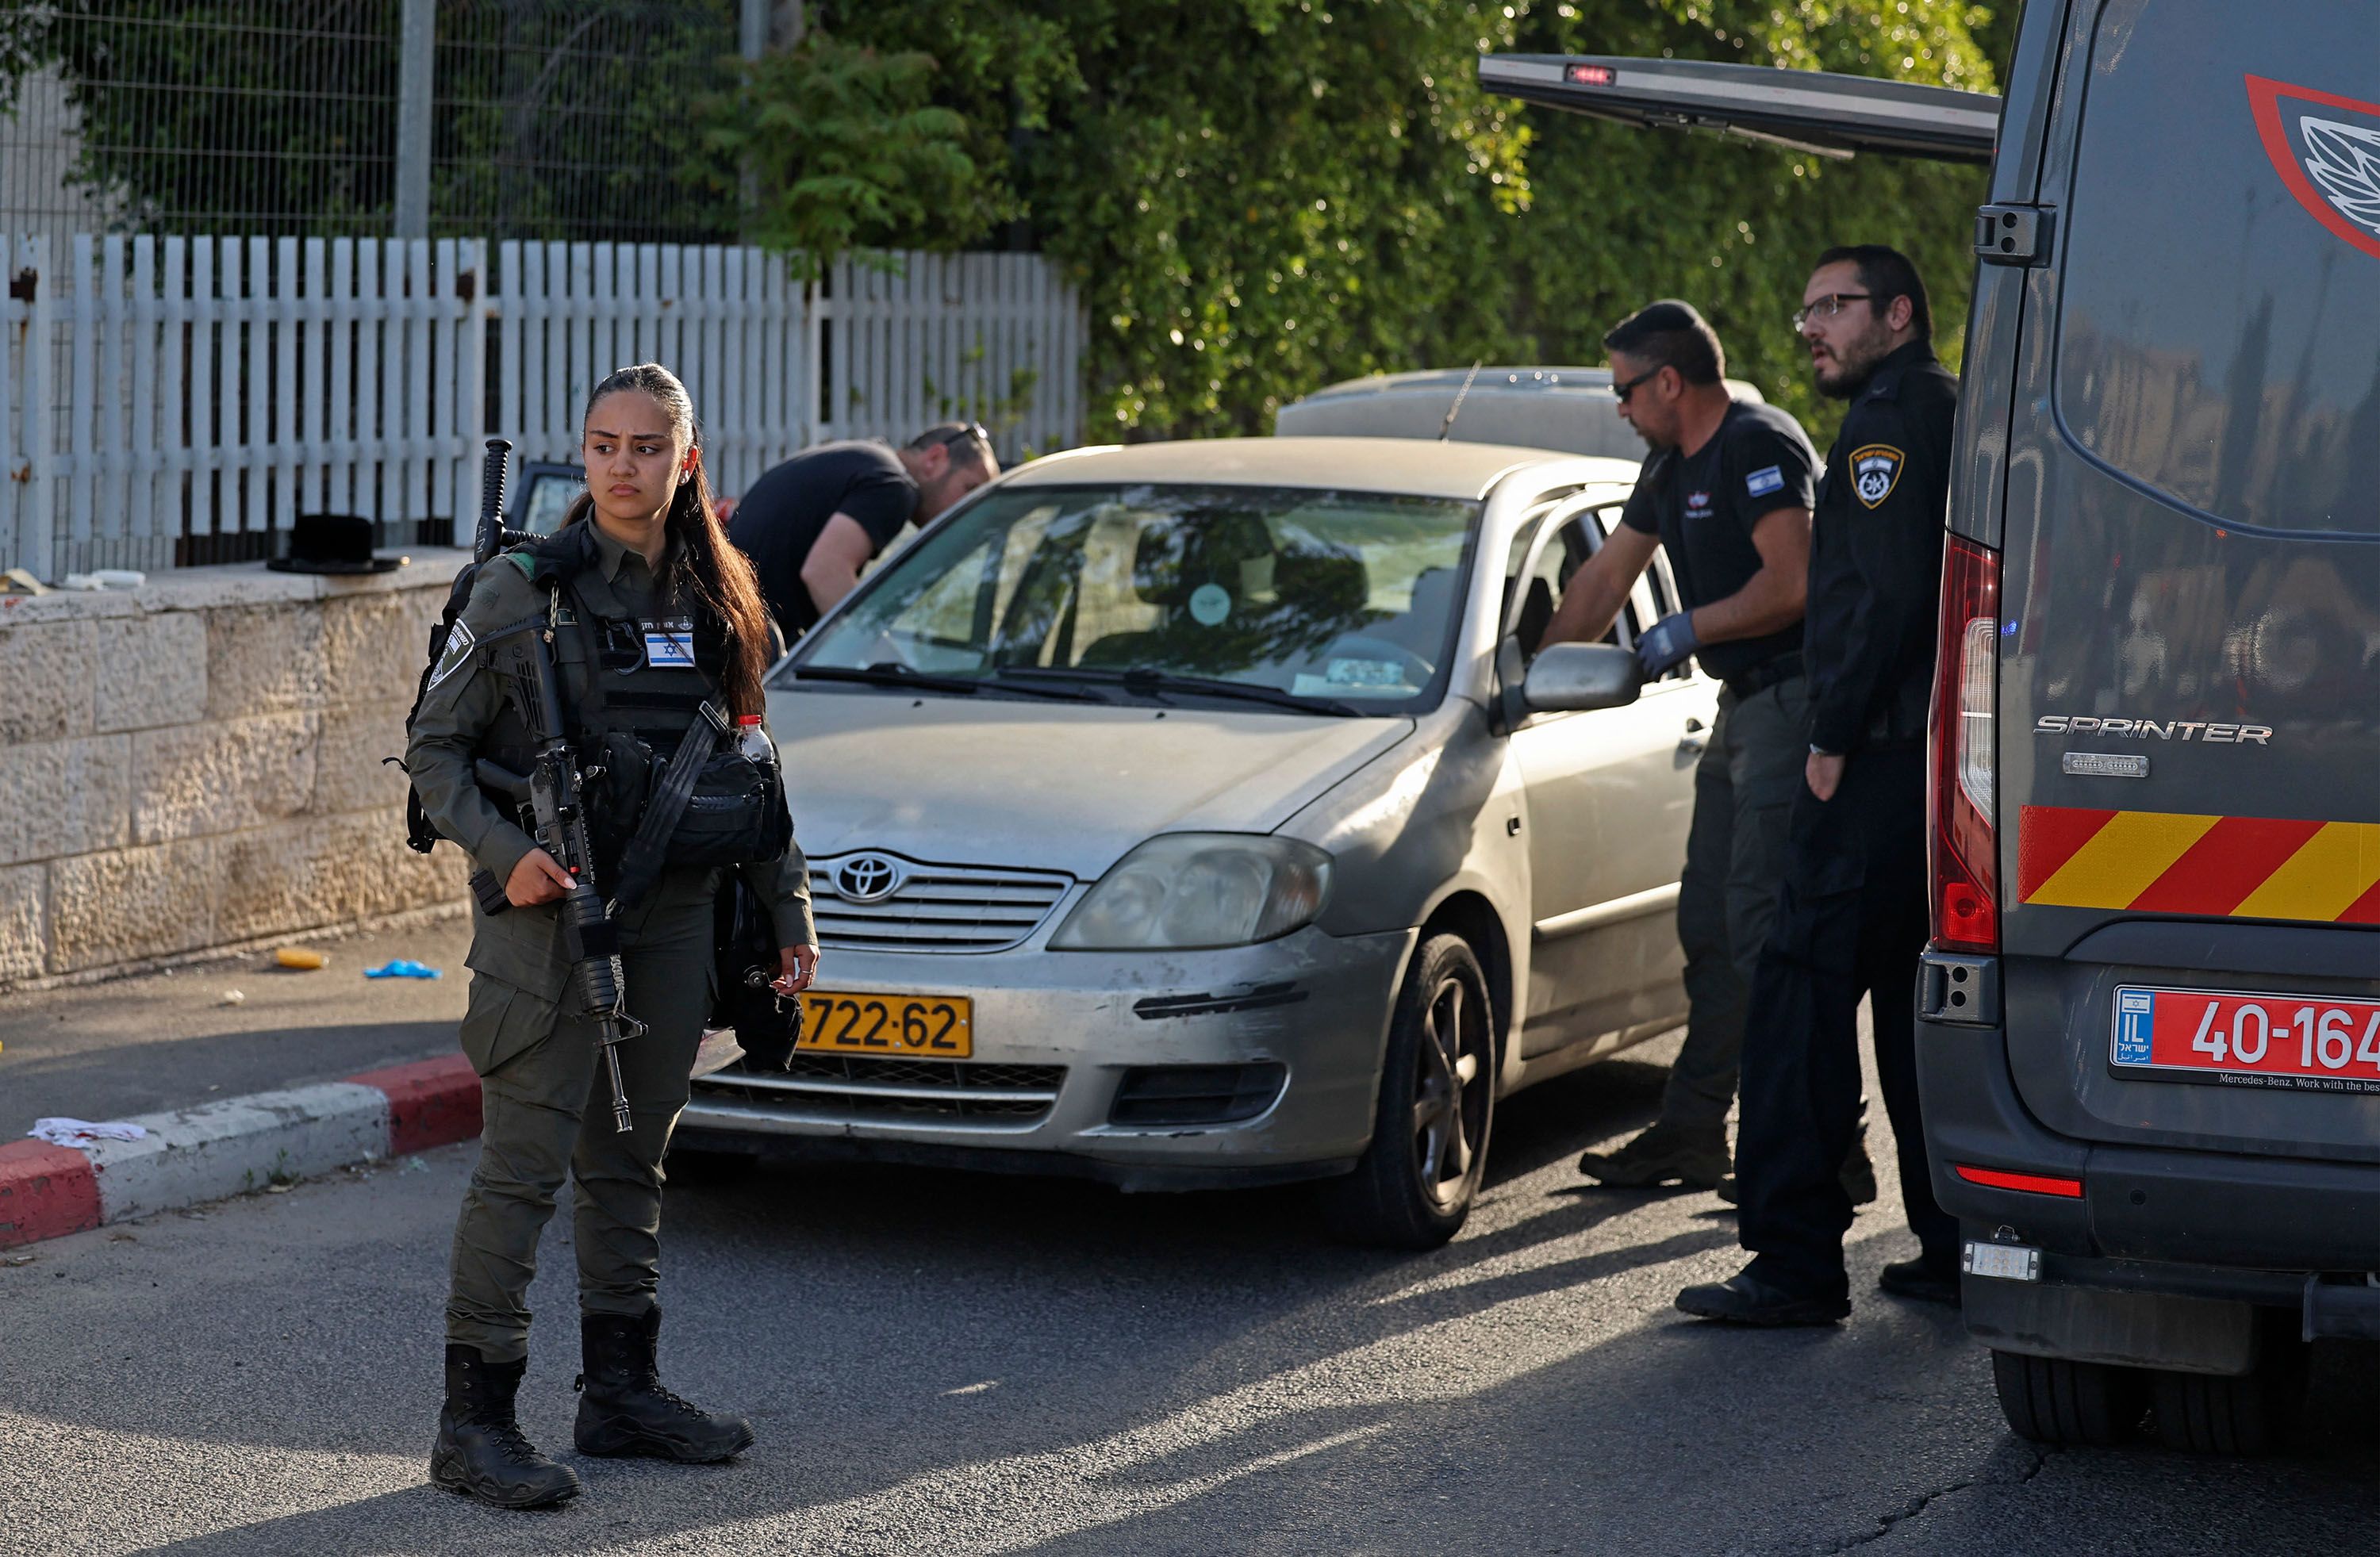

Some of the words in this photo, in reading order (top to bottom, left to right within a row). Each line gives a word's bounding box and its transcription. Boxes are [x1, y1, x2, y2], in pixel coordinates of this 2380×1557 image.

[2033, 715, 2274, 745] SPRINTER
[2124, 1014, 2144, 1042] IL
[2118, 1042, 2149, 1053] ישראל
[2219, 1073, 2293, 1087] Mercedes-Benz.
[2296, 1078, 2320, 1089] Work
[2323, 1080, 2344, 1090] with
[2346, 1081, 2362, 1091] the
